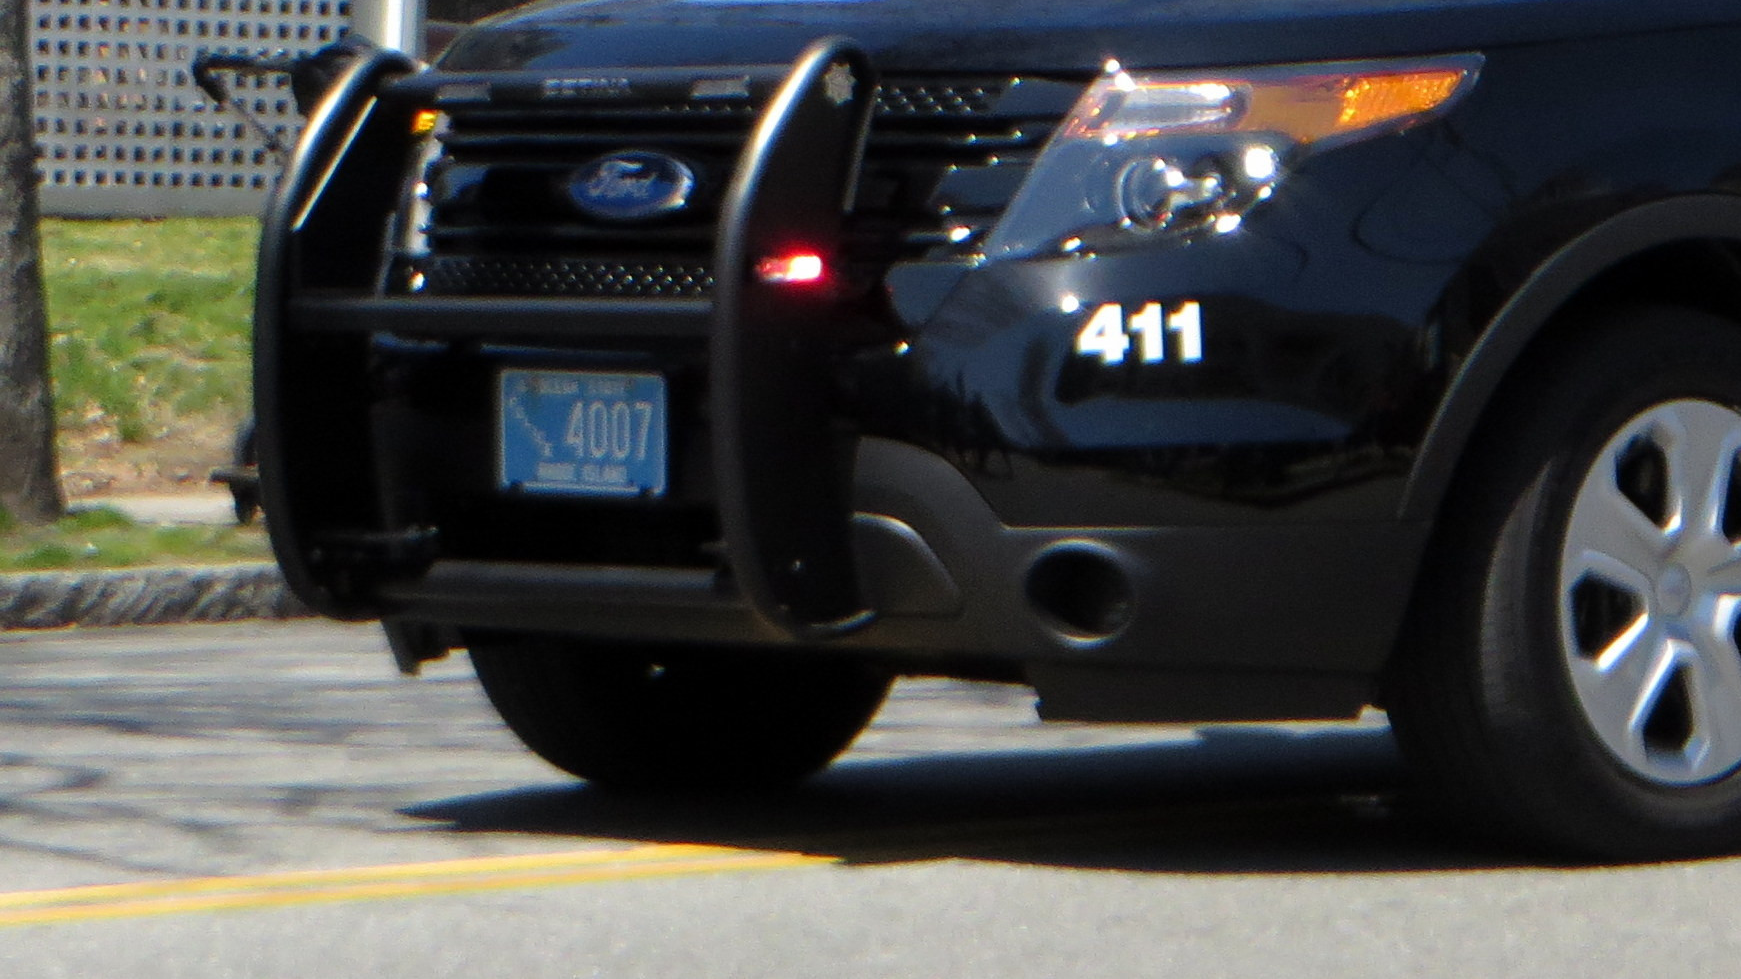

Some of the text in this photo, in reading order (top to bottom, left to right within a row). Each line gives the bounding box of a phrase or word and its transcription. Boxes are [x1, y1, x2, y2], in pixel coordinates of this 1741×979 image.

[588, 159, 658, 199] Ford
[1076, 301, 1203, 365] 411
[565, 400, 653, 461] 4007
